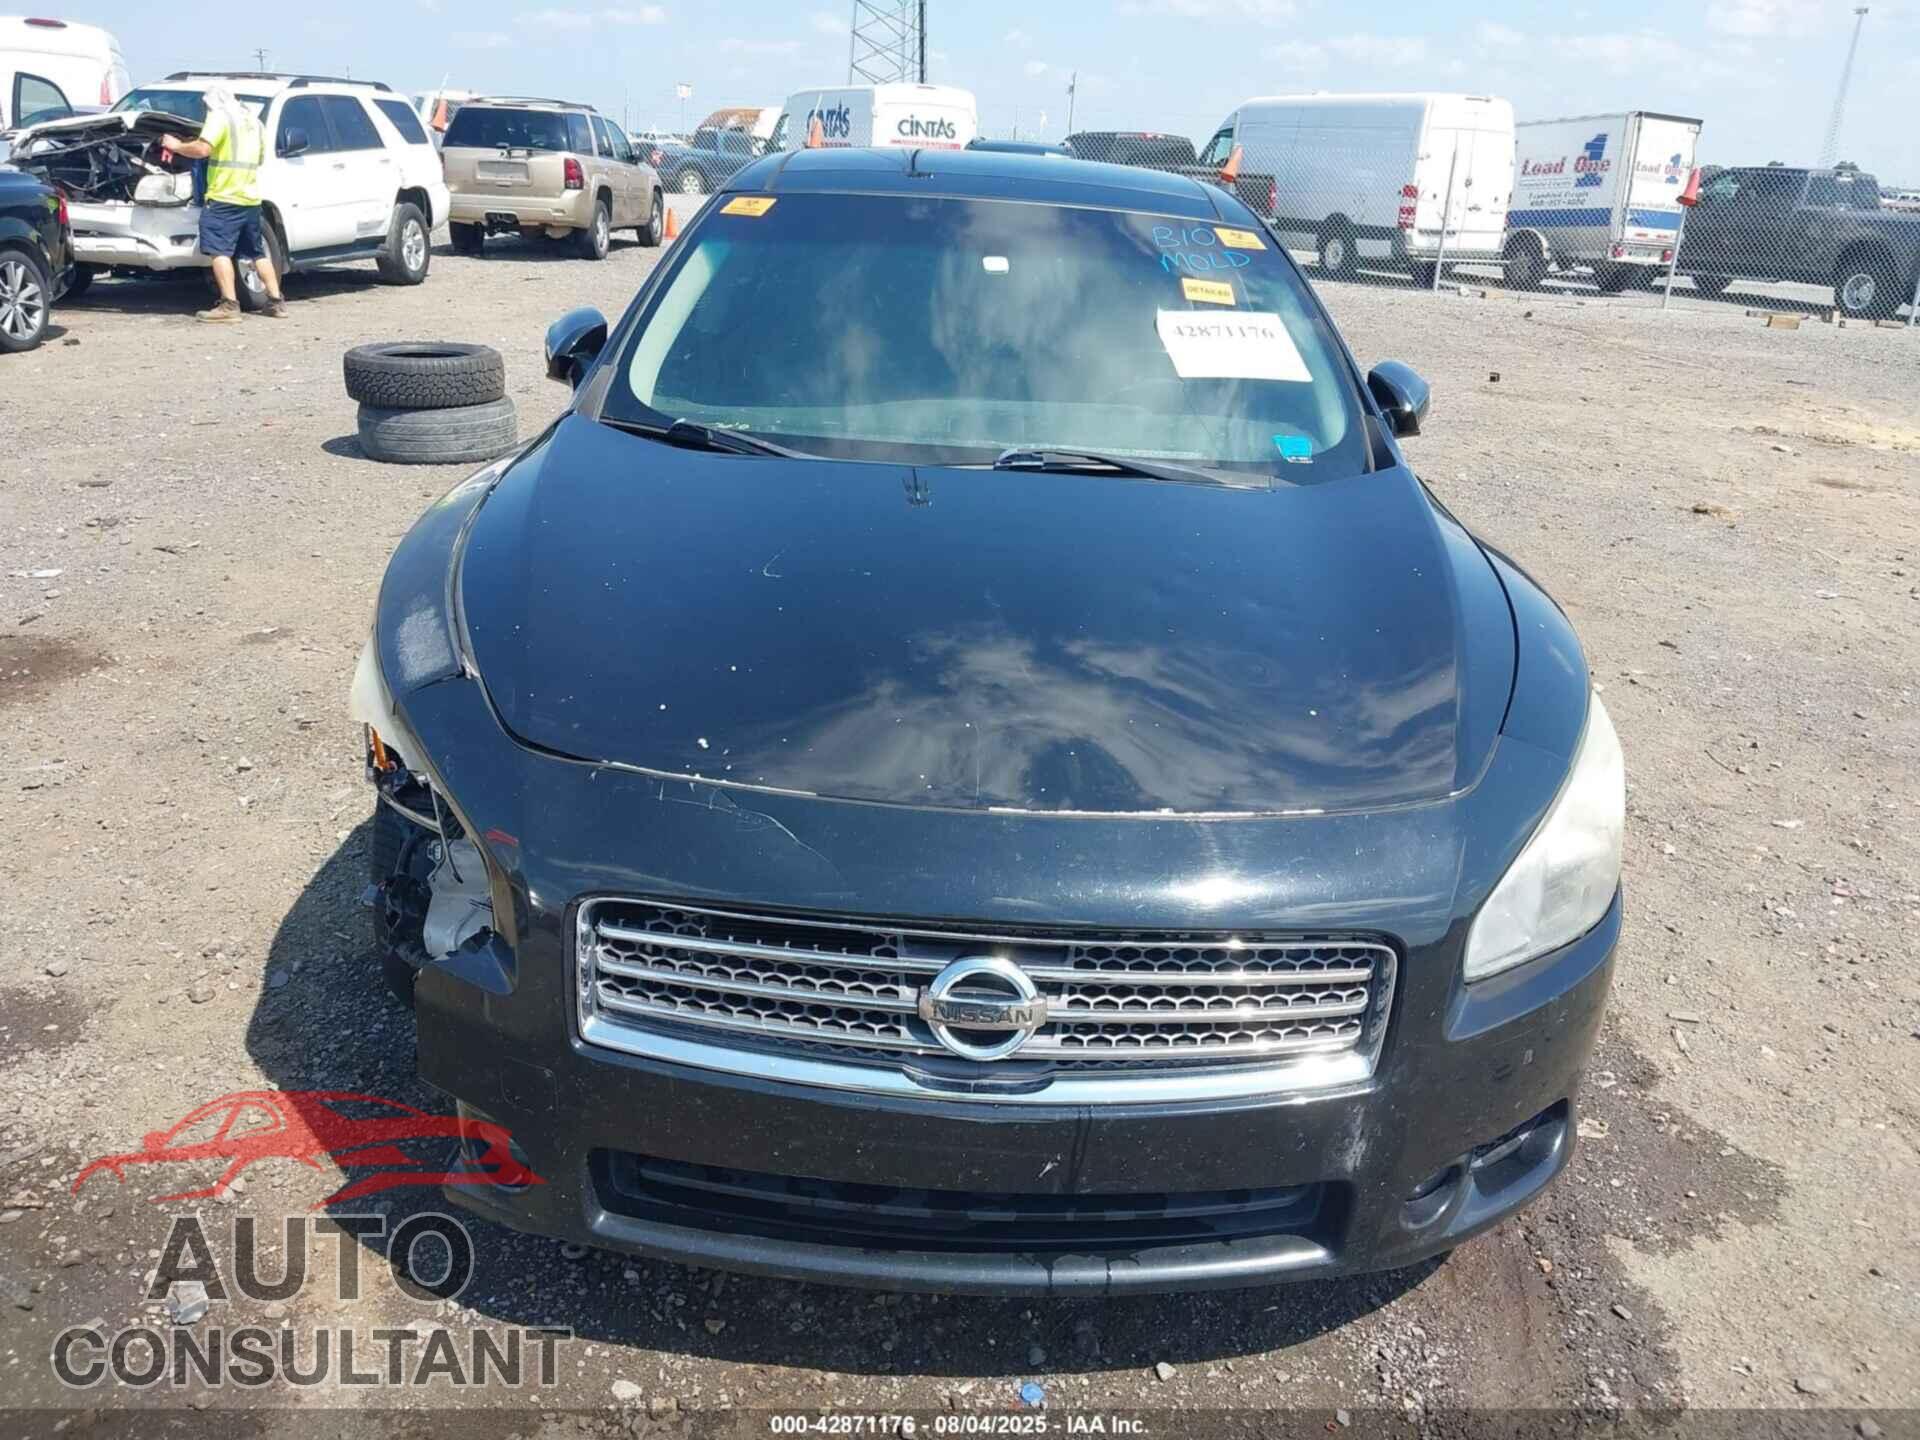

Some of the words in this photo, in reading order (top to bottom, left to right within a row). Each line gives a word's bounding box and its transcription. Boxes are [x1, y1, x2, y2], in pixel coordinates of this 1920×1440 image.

[897, 114, 956, 139] CINTAS
[1521, 157, 1566, 176] Load
[1574, 155, 1611, 173] One
[1152, 226, 1216, 248] BIO
[1160, 251, 1251, 273] MOLD
[1174, 325, 1276, 339] 42871176
[932, 1001, 1034, 1024] NISSAN
